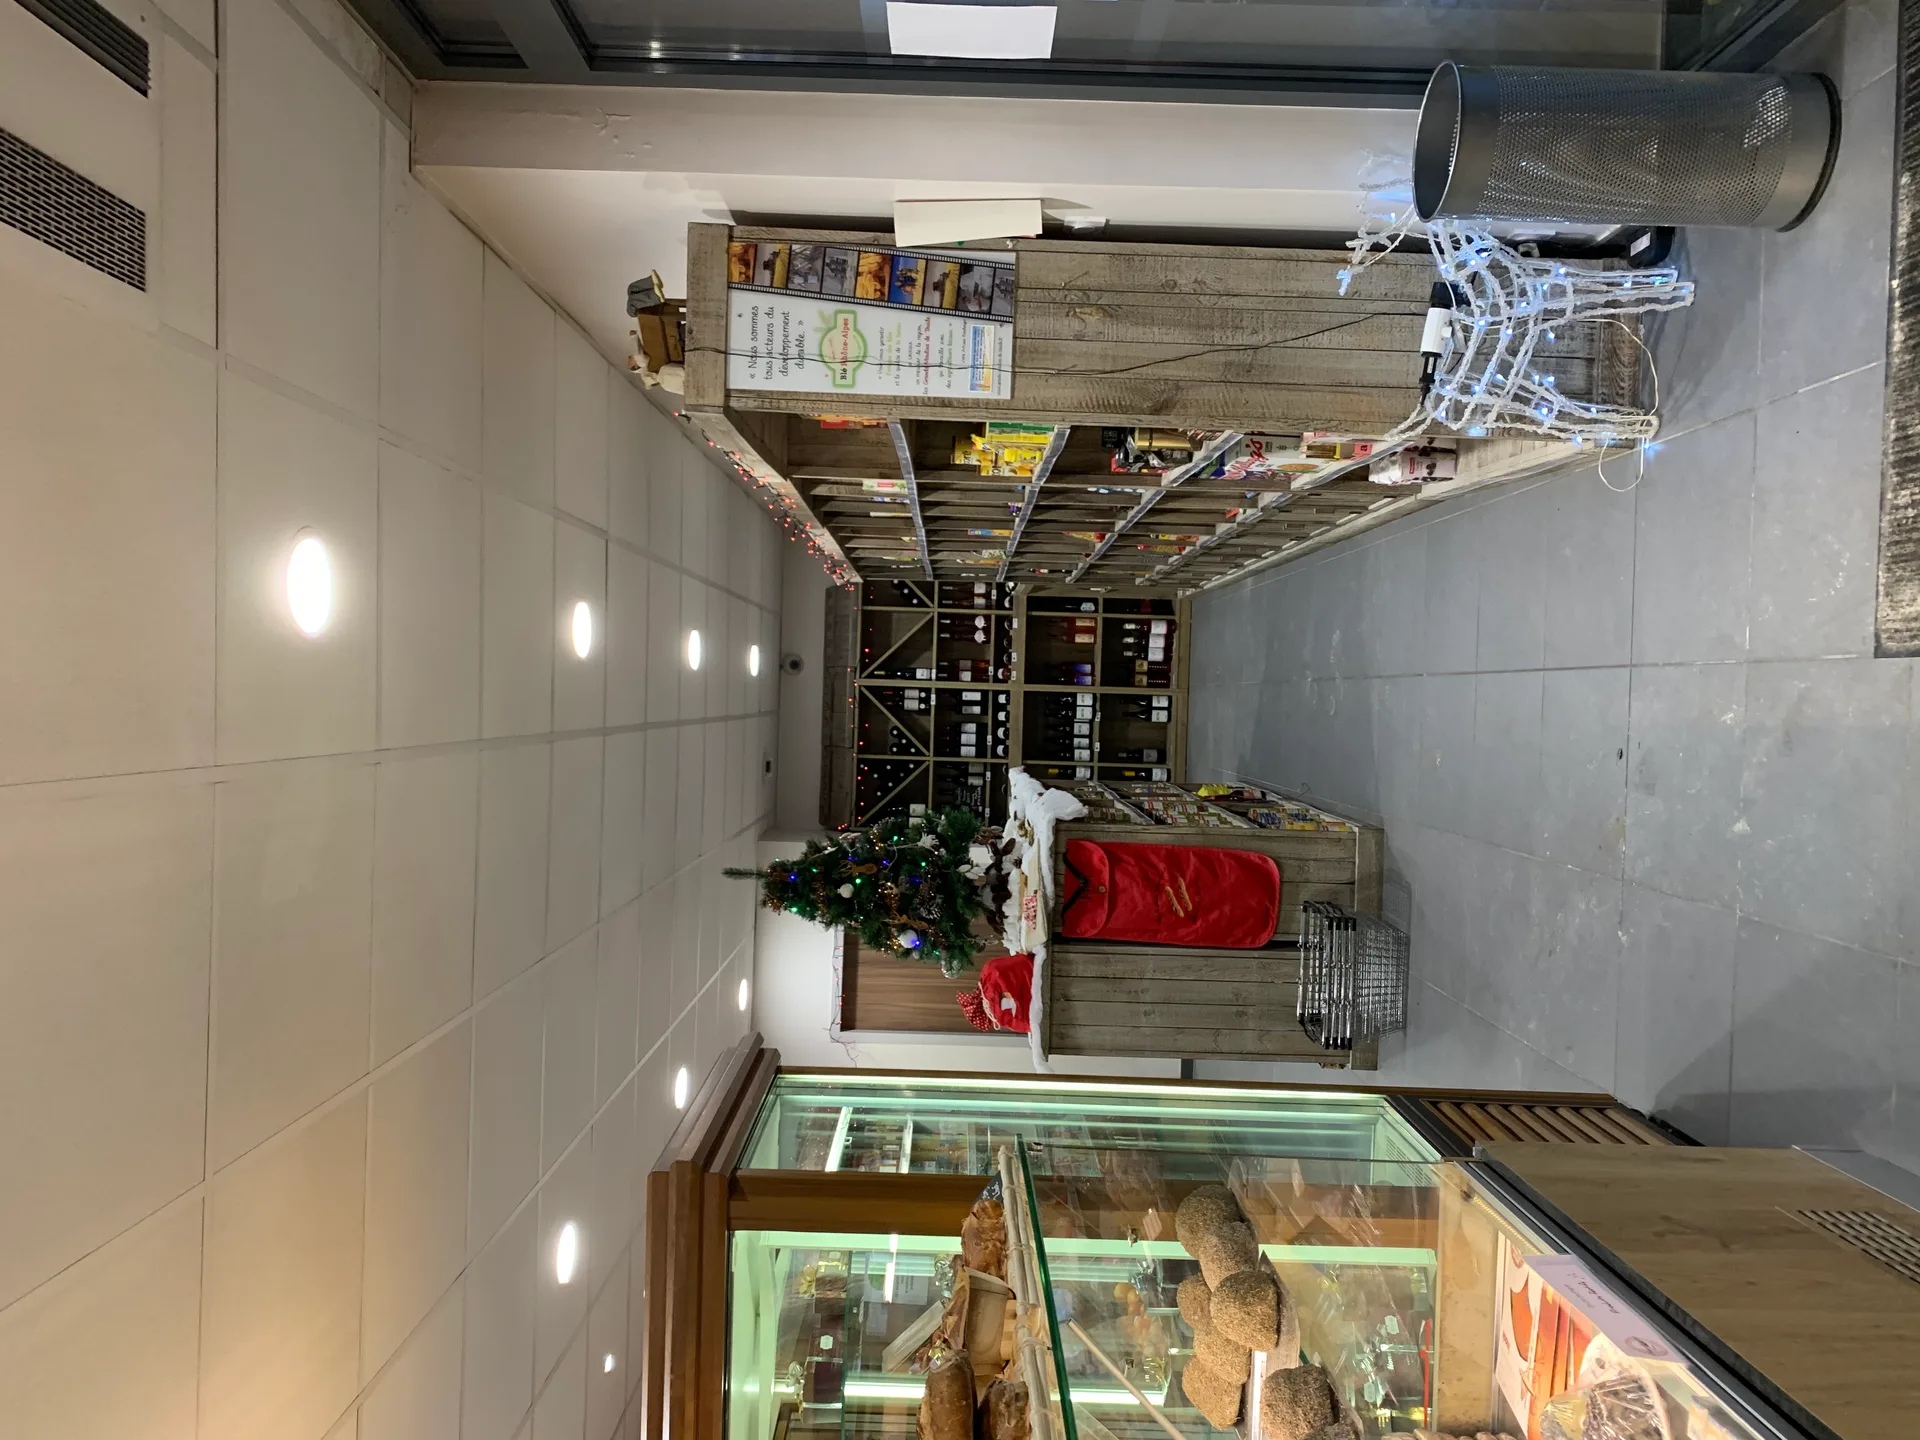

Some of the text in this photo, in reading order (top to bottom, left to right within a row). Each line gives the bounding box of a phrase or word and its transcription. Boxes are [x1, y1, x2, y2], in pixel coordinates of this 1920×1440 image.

[748, 346, 758, 368] Nous
[764, 306, 774, 380] tous acteurs du
[779, 311, 791, 376] développement
[840, 318, 850, 366] Rhône-Alpes
